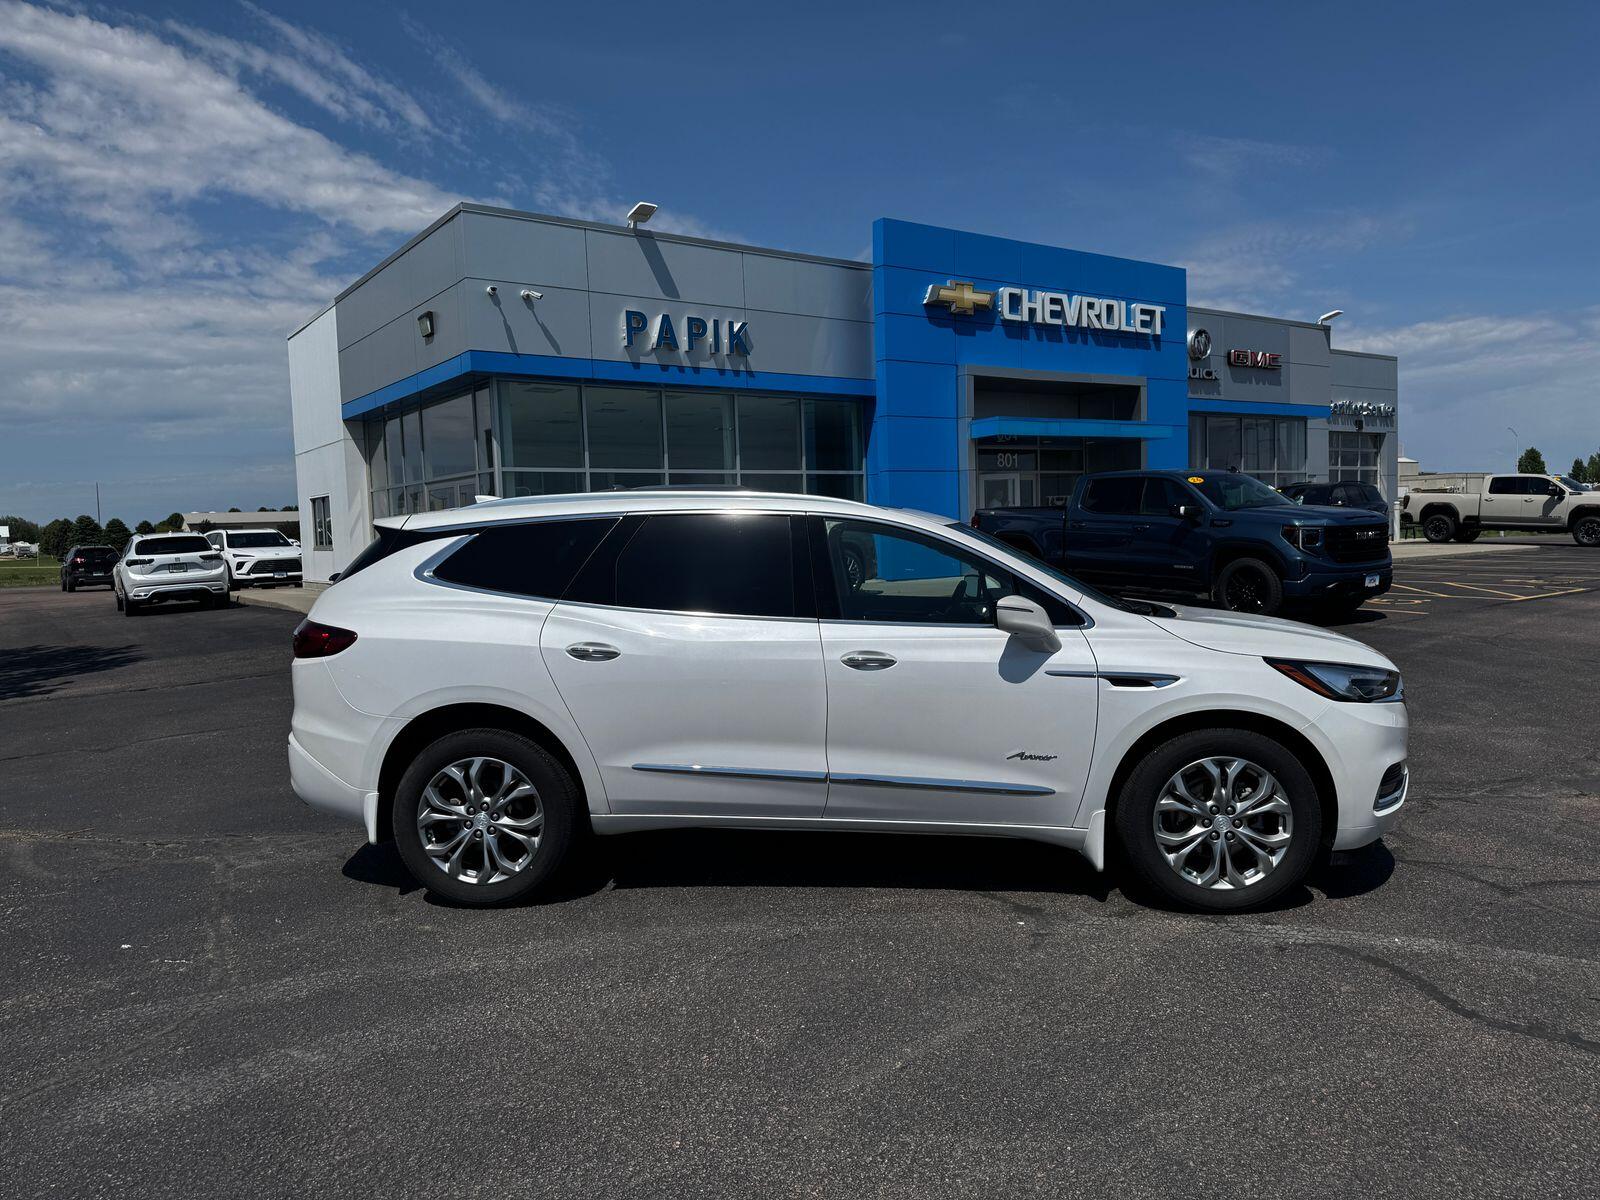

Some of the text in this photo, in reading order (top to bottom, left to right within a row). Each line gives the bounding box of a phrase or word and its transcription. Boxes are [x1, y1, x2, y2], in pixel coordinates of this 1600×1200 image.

[999, 286, 1166, 335] CHEVROLET
[623, 309, 750, 356] PAPIK
[1228, 349, 1282, 369] GMC
[1187, 367, 1219, 380] UICK
[997, 453, 1018, 468] 801
